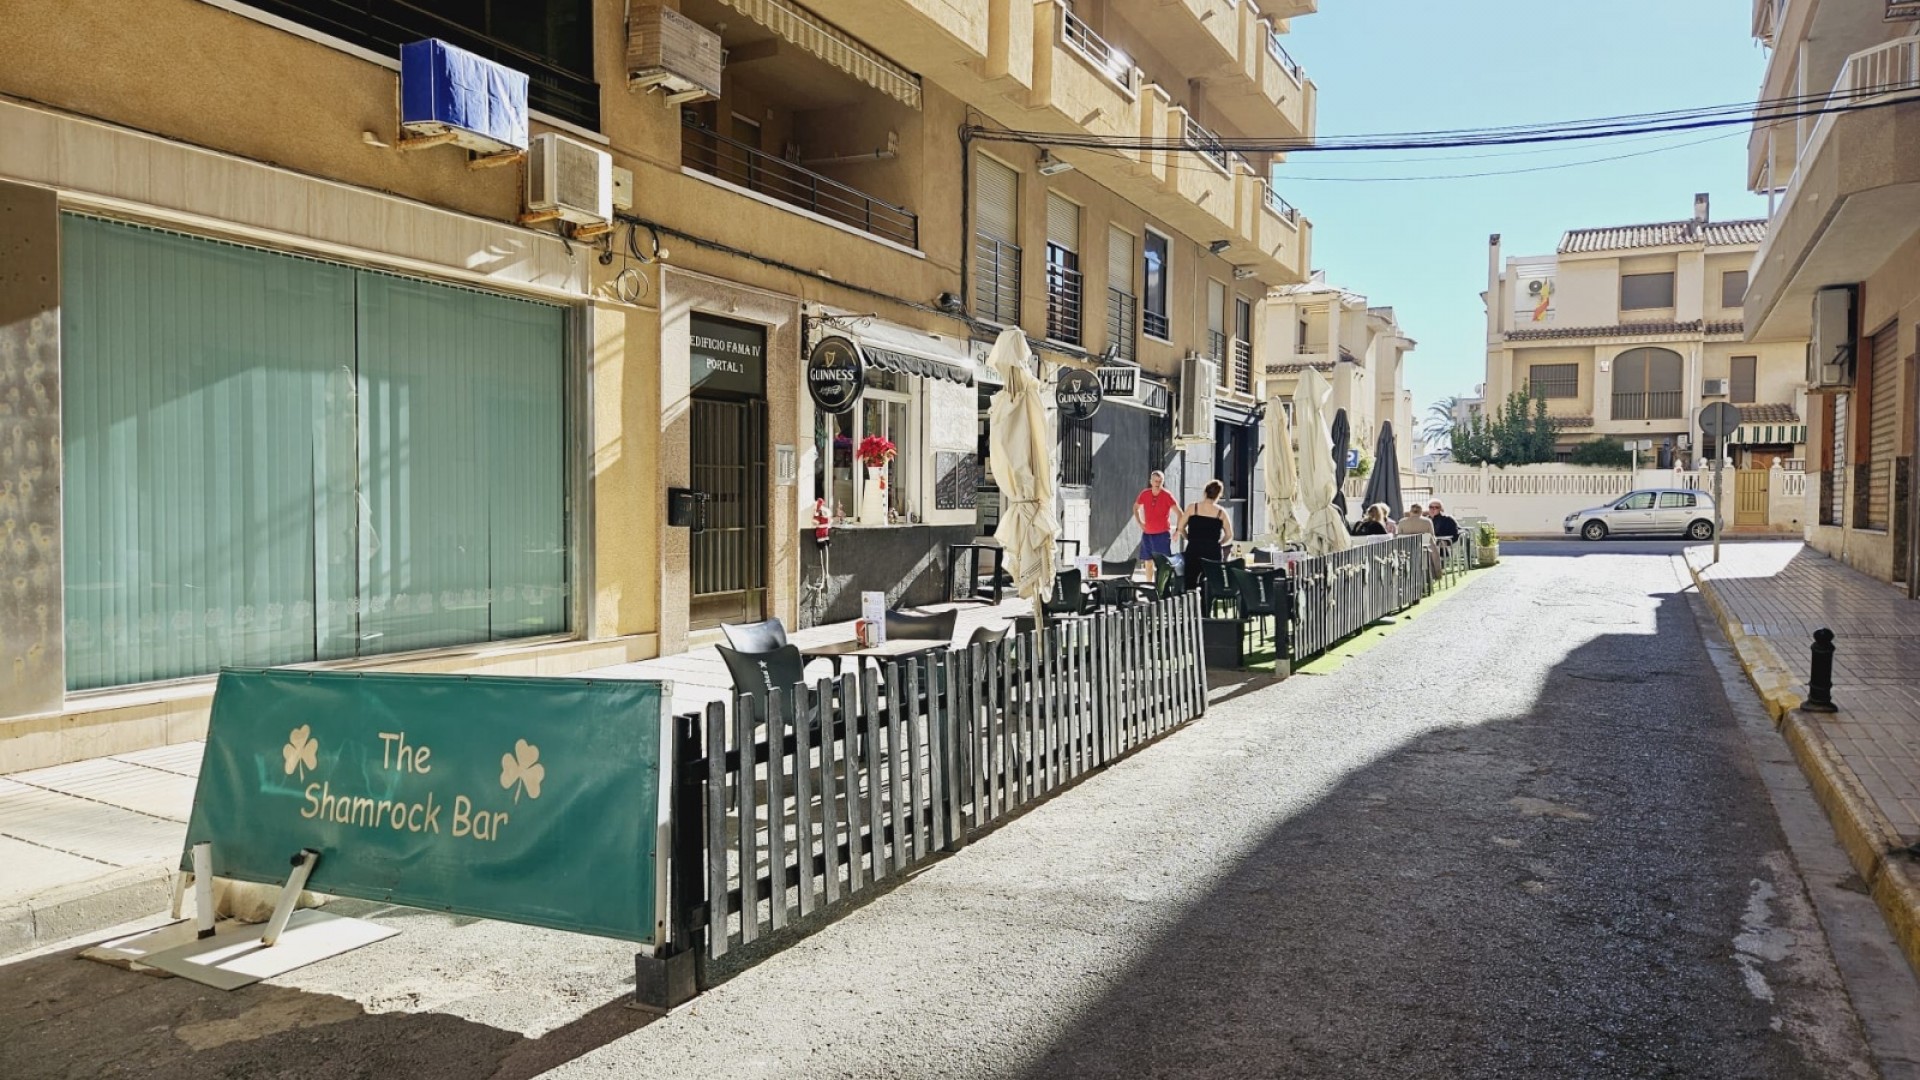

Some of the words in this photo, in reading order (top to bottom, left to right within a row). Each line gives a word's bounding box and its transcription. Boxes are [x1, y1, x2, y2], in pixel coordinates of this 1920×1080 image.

[690, 335, 725, 352] EDIFICIO
[726, 341, 751, 356] FAMA
[751, 345, 761, 357] IV
[706, 357, 739, 373] PORTAL
[809, 368, 854, 381] GUINNESS
[1058, 392, 1098, 403] GUINNESS
[378, 731, 432, 775] The
[300, 781, 440, 835] Shamrock
[451, 795, 509, 841] Bar
